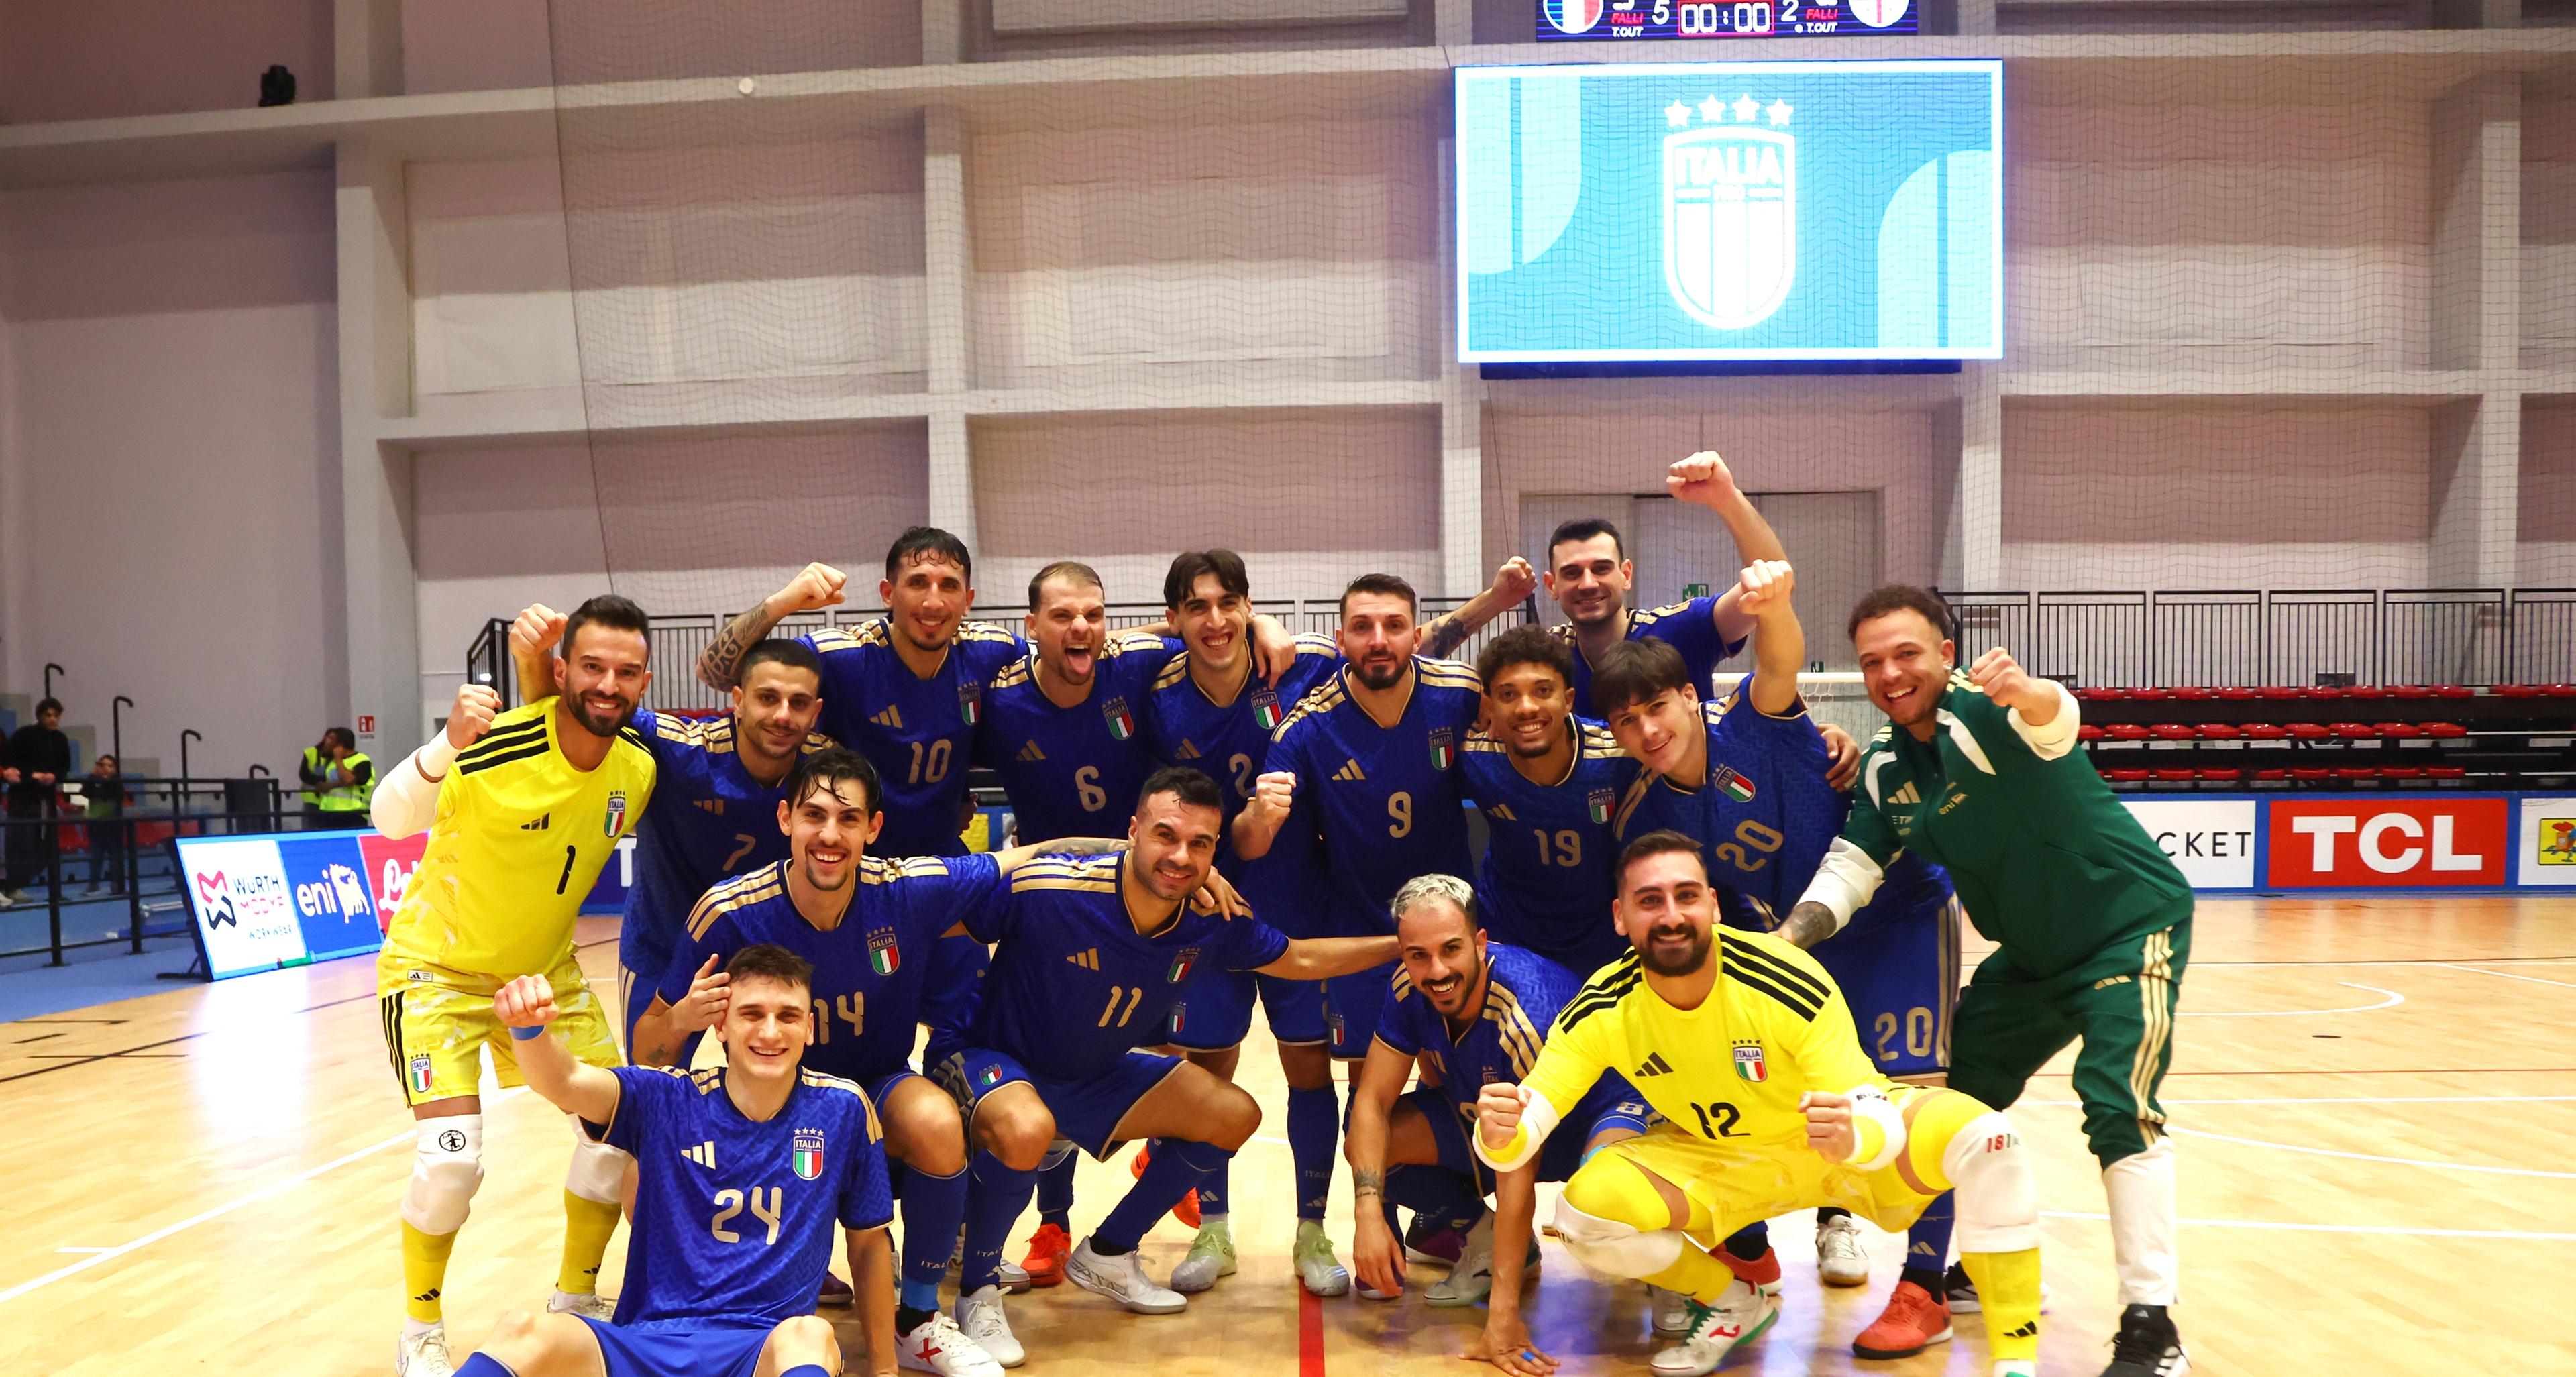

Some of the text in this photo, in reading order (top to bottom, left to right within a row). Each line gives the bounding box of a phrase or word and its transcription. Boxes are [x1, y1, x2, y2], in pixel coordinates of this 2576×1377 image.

[1611, 12, 1644, 25] FALLI
[1652, 0, 1671, 25] 5
[1681, 3, 1770, 34] 00:00
[1781, 0, 1799, 21] 2
[1806, 8, 1838, 20] FALLI
[1806, 22, 1838, 33] T.OUT
[1611, 27, 1644, 38] T.OUT
[1674, 146, 1782, 185] ITALIA
[1107, 706, 1126, 717] ITALIA
[1253, 694, 1275, 705] ITALIA
[1430, 734, 1452, 745] ITALIA
[908, 738, 953, 784] 10
[1228, 753, 1256, 797] 2
[610, 800, 624, 808] ITALIA
[1074, 765, 1106, 812] 6
[1591, 795, 1612, 805] ITALIA
[1387, 791, 1412, 838] 9
[722, 834, 757, 871] 7
[1533, 828, 1582, 868] 19
[1715, 820, 1784, 872] 20
[2292, 812, 2482, 873] TCL
[556, 845, 576, 895] 1
[297, 869, 337, 917] eni
[869, 937, 893, 950] ITALIA
[813, 991, 865, 1045] 14
[1097, 985, 1142, 1028] 11
[1874, 1007, 1933, 1062] 20
[1735, 1050, 1761, 1058] ITALIA
[1690, 1101, 1750, 1140] 12
[795, 1140, 821, 1148] ITALIA
[712, 1186, 782, 1245] 24
